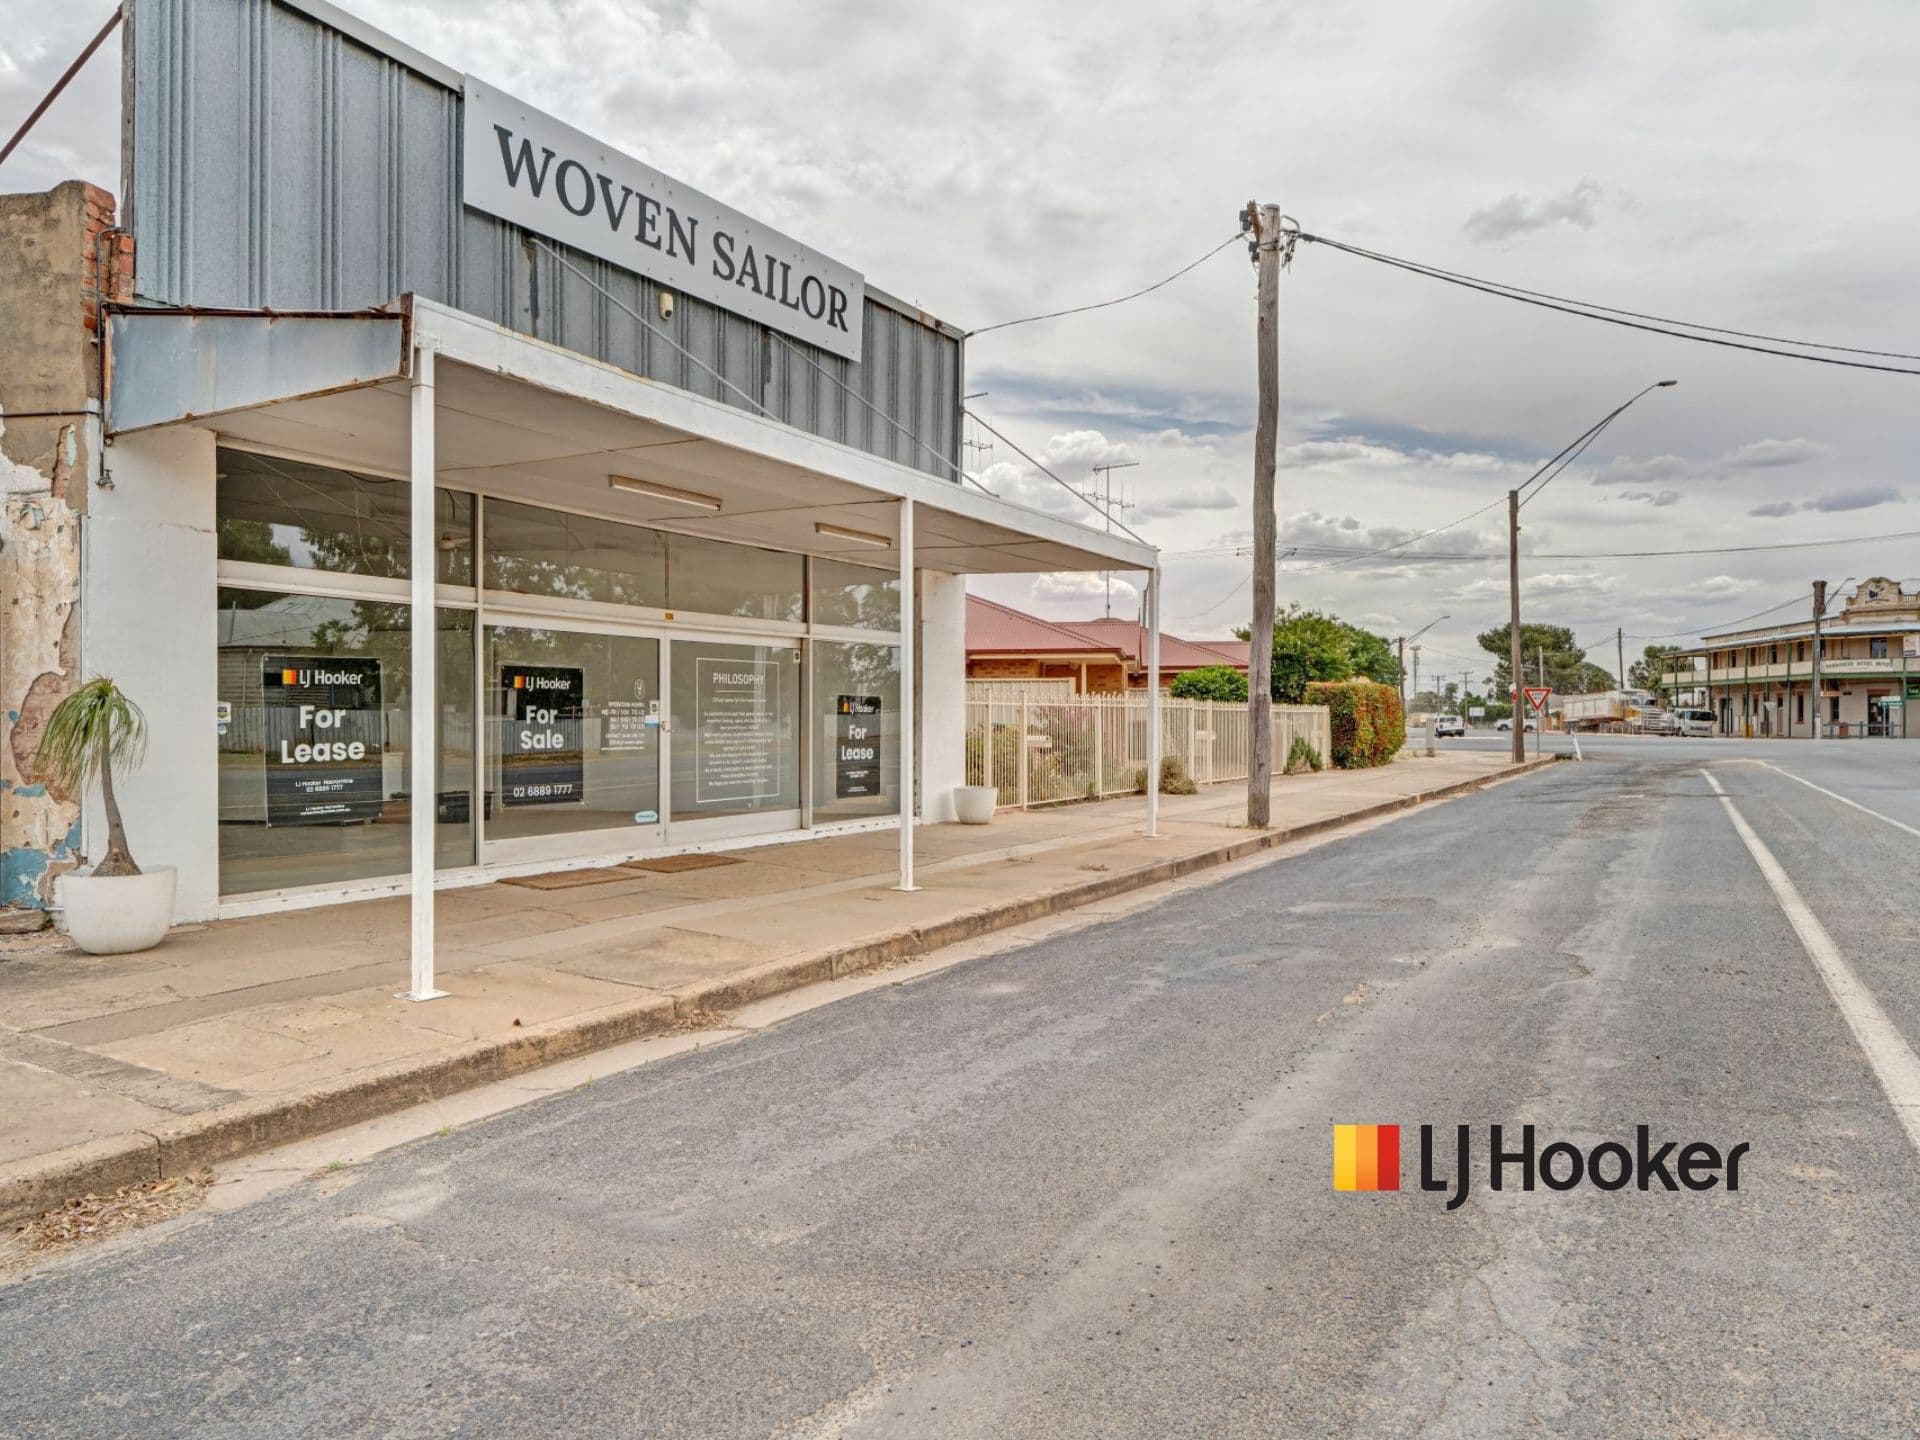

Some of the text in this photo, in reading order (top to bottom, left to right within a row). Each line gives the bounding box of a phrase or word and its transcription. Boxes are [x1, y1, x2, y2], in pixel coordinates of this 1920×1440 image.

[493, 123, 848, 333] WOVEN SAILOR
[299, 670, 363, 688] LJ Hooker
[526, 677, 571, 692] LJ Hooker
[713, 673, 765, 685] PHILOSOPHY
[300, 705, 346, 729] For
[525, 705, 558, 725] For
[520, 729, 564, 749] Sale
[848, 725, 867, 740] For
[281, 740, 366, 764] Lease
[841, 745, 874, 761] Lease
[513, 784, 572, 797] 02 6889 1777
